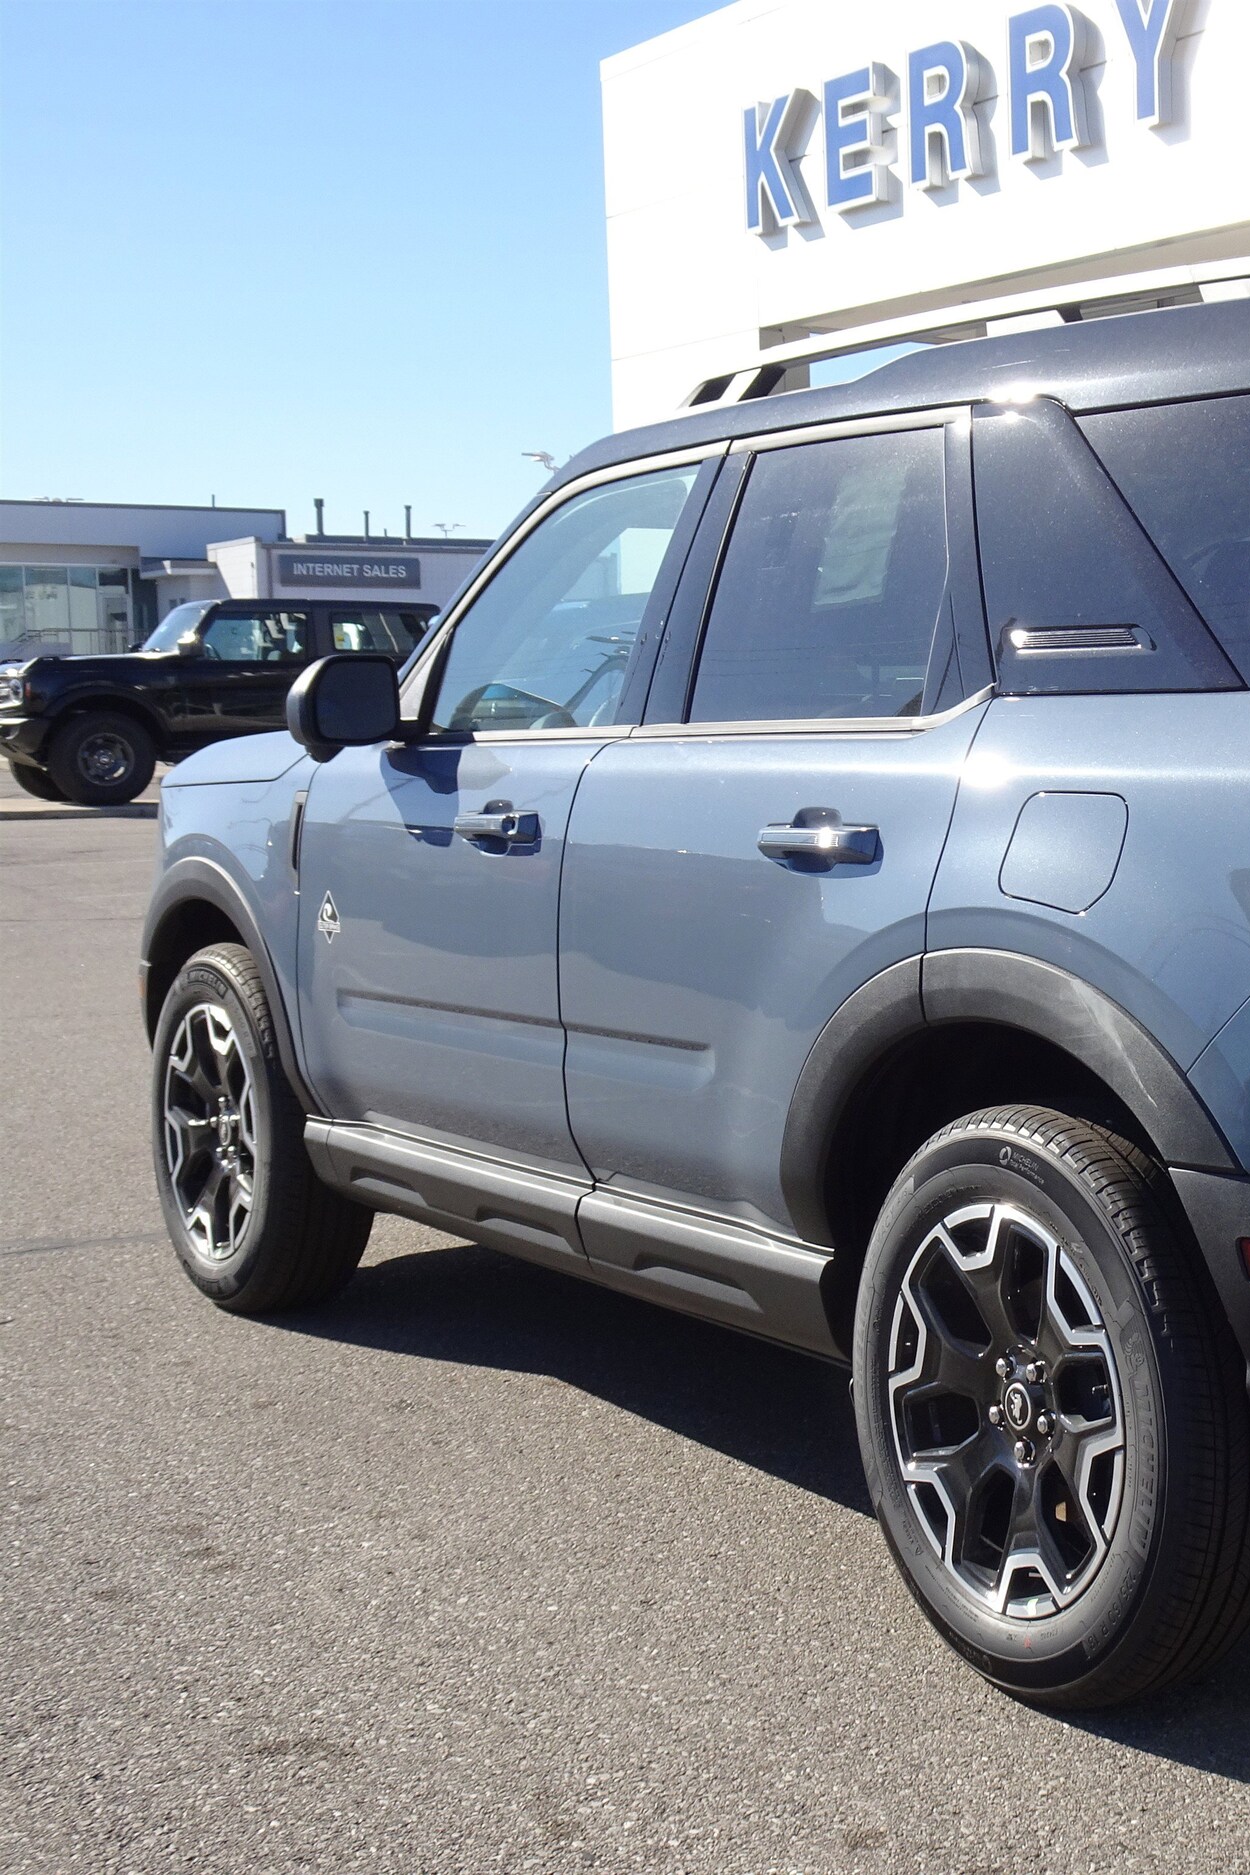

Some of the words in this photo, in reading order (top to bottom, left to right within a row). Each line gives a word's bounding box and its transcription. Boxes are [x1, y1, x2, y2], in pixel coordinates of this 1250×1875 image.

[742, 0, 1184, 234] KERRY
[293, 562, 359, 576] INTERNET
[363, 564, 406, 578] SALES
[1132, 1378, 1156, 1550] MICHELIN
